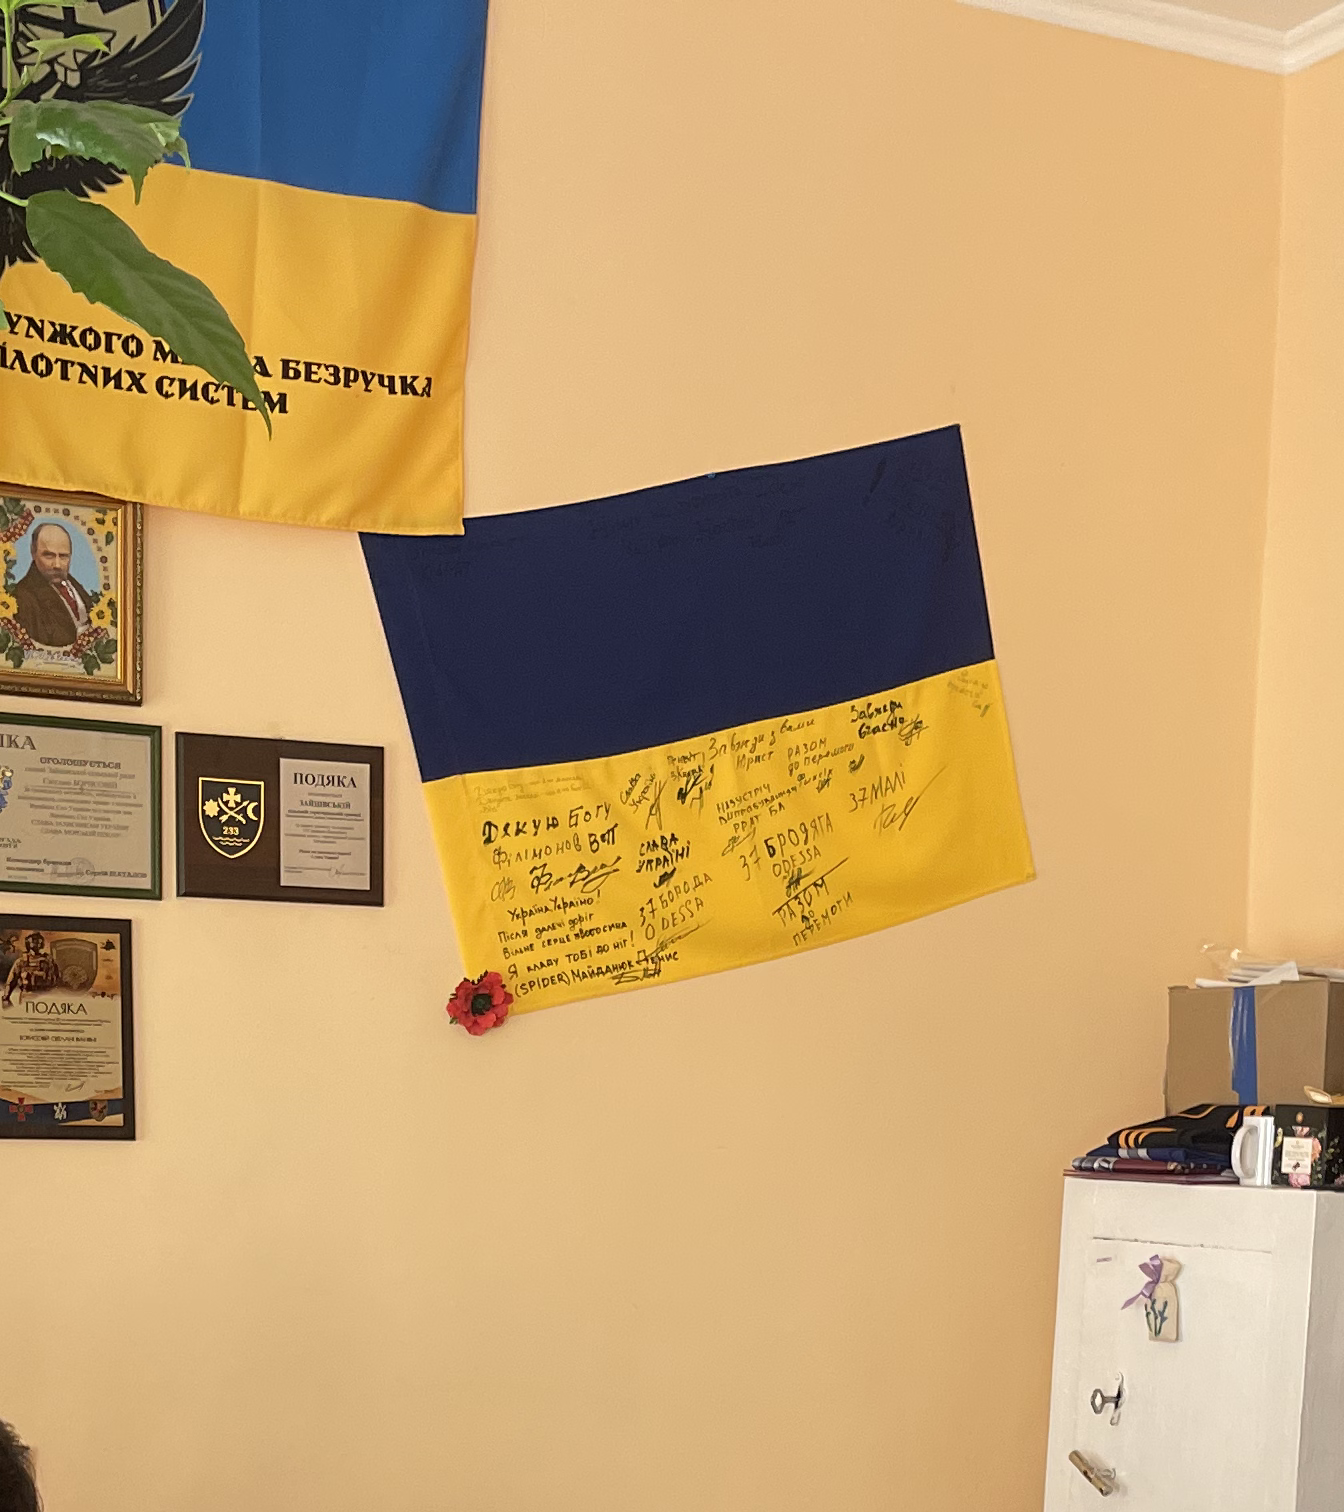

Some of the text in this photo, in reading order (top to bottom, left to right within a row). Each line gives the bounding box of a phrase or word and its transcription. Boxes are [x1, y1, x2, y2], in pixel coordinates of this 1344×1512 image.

[280, 357, 433, 398] БЕЗРУЧКА
[293, 772, 357, 789] ПОДЯКА
[222, 825, 239, 835] 233
[508, 963, 518, 980] Я
[25, 1001, 88, 1015] ПОДЯКА
